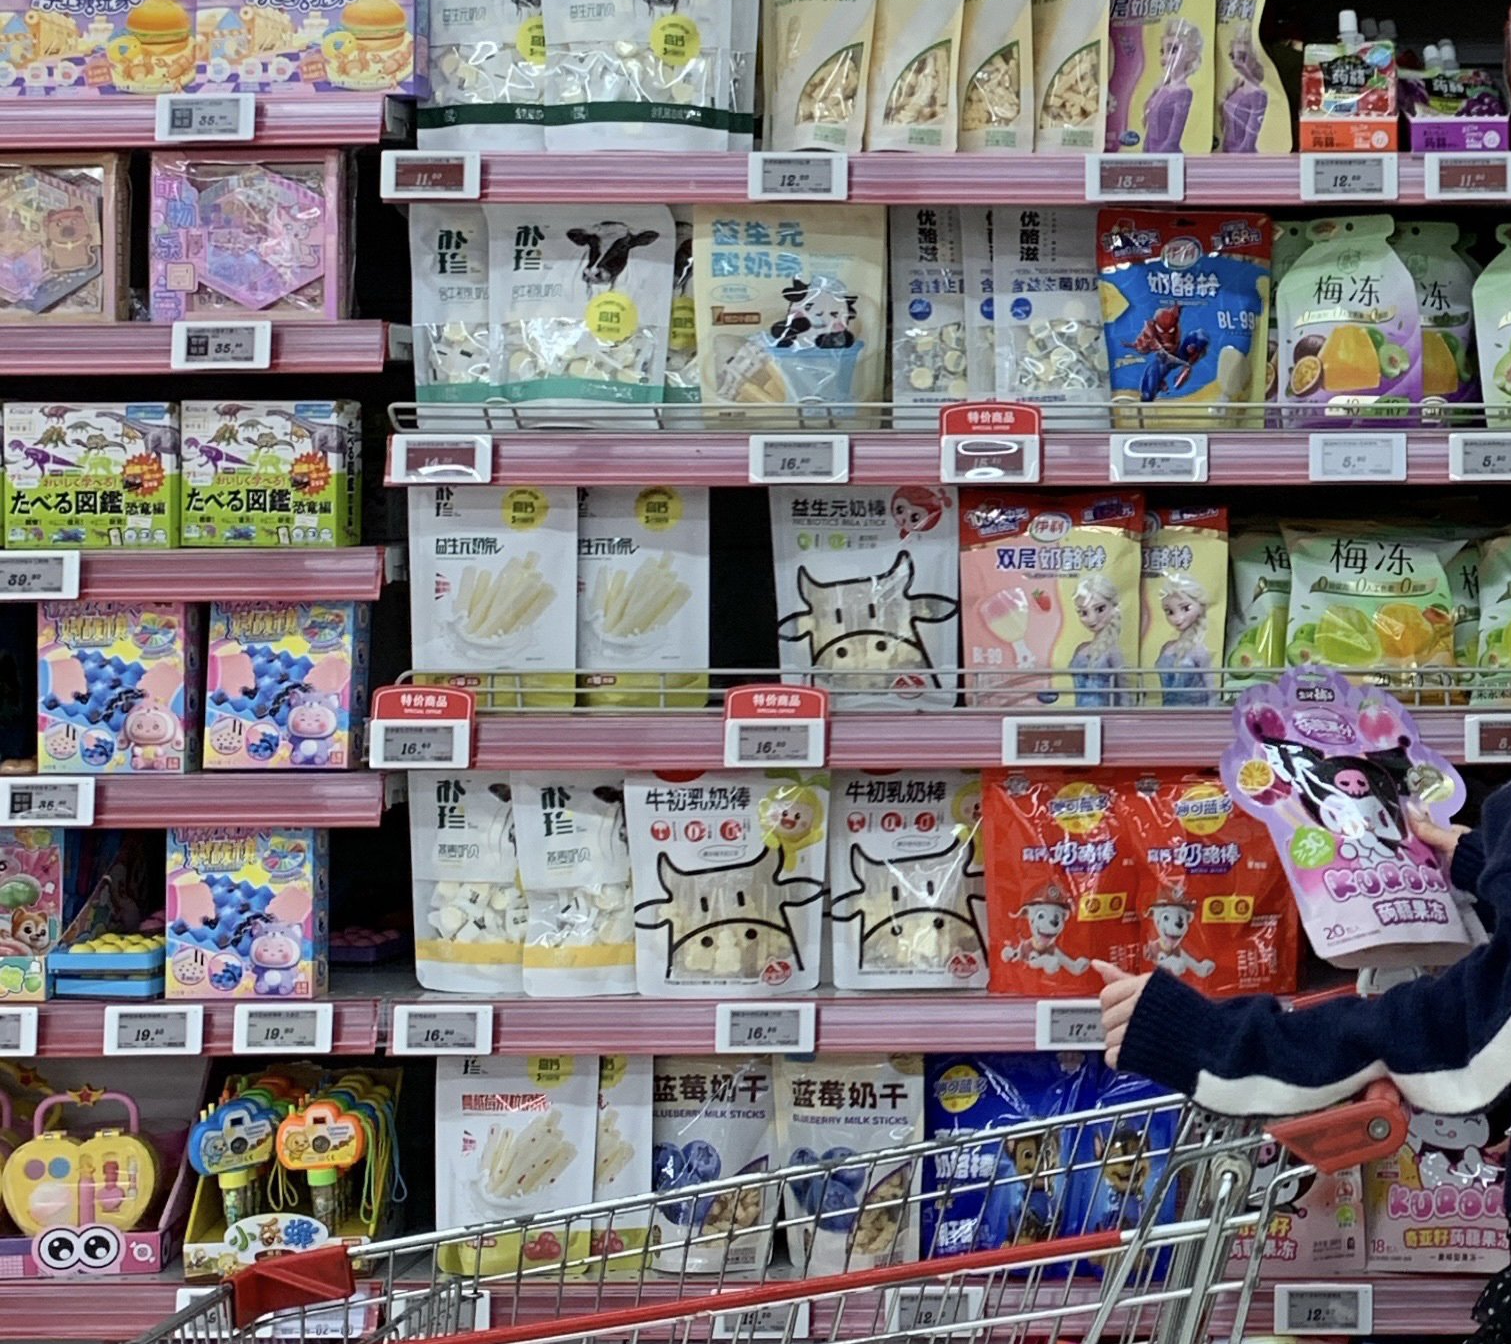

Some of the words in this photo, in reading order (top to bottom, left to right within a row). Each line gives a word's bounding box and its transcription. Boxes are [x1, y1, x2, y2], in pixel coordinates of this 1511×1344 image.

[1312, 275, 1383, 306] 梅冻
[10, 488, 125, 516] たべる図鑑
[186, 487, 292, 514] たべる図鑑
[996, 545, 1107, 570] 双层奶酪棒
[1330, 537, 1415, 577] 梅冻
[645, 786, 752, 812] 牛初乳奶棒
[845, 780, 947, 806] 牛初乳奶棒
[791, 1078, 908, 1110] 蓝莓奶干
